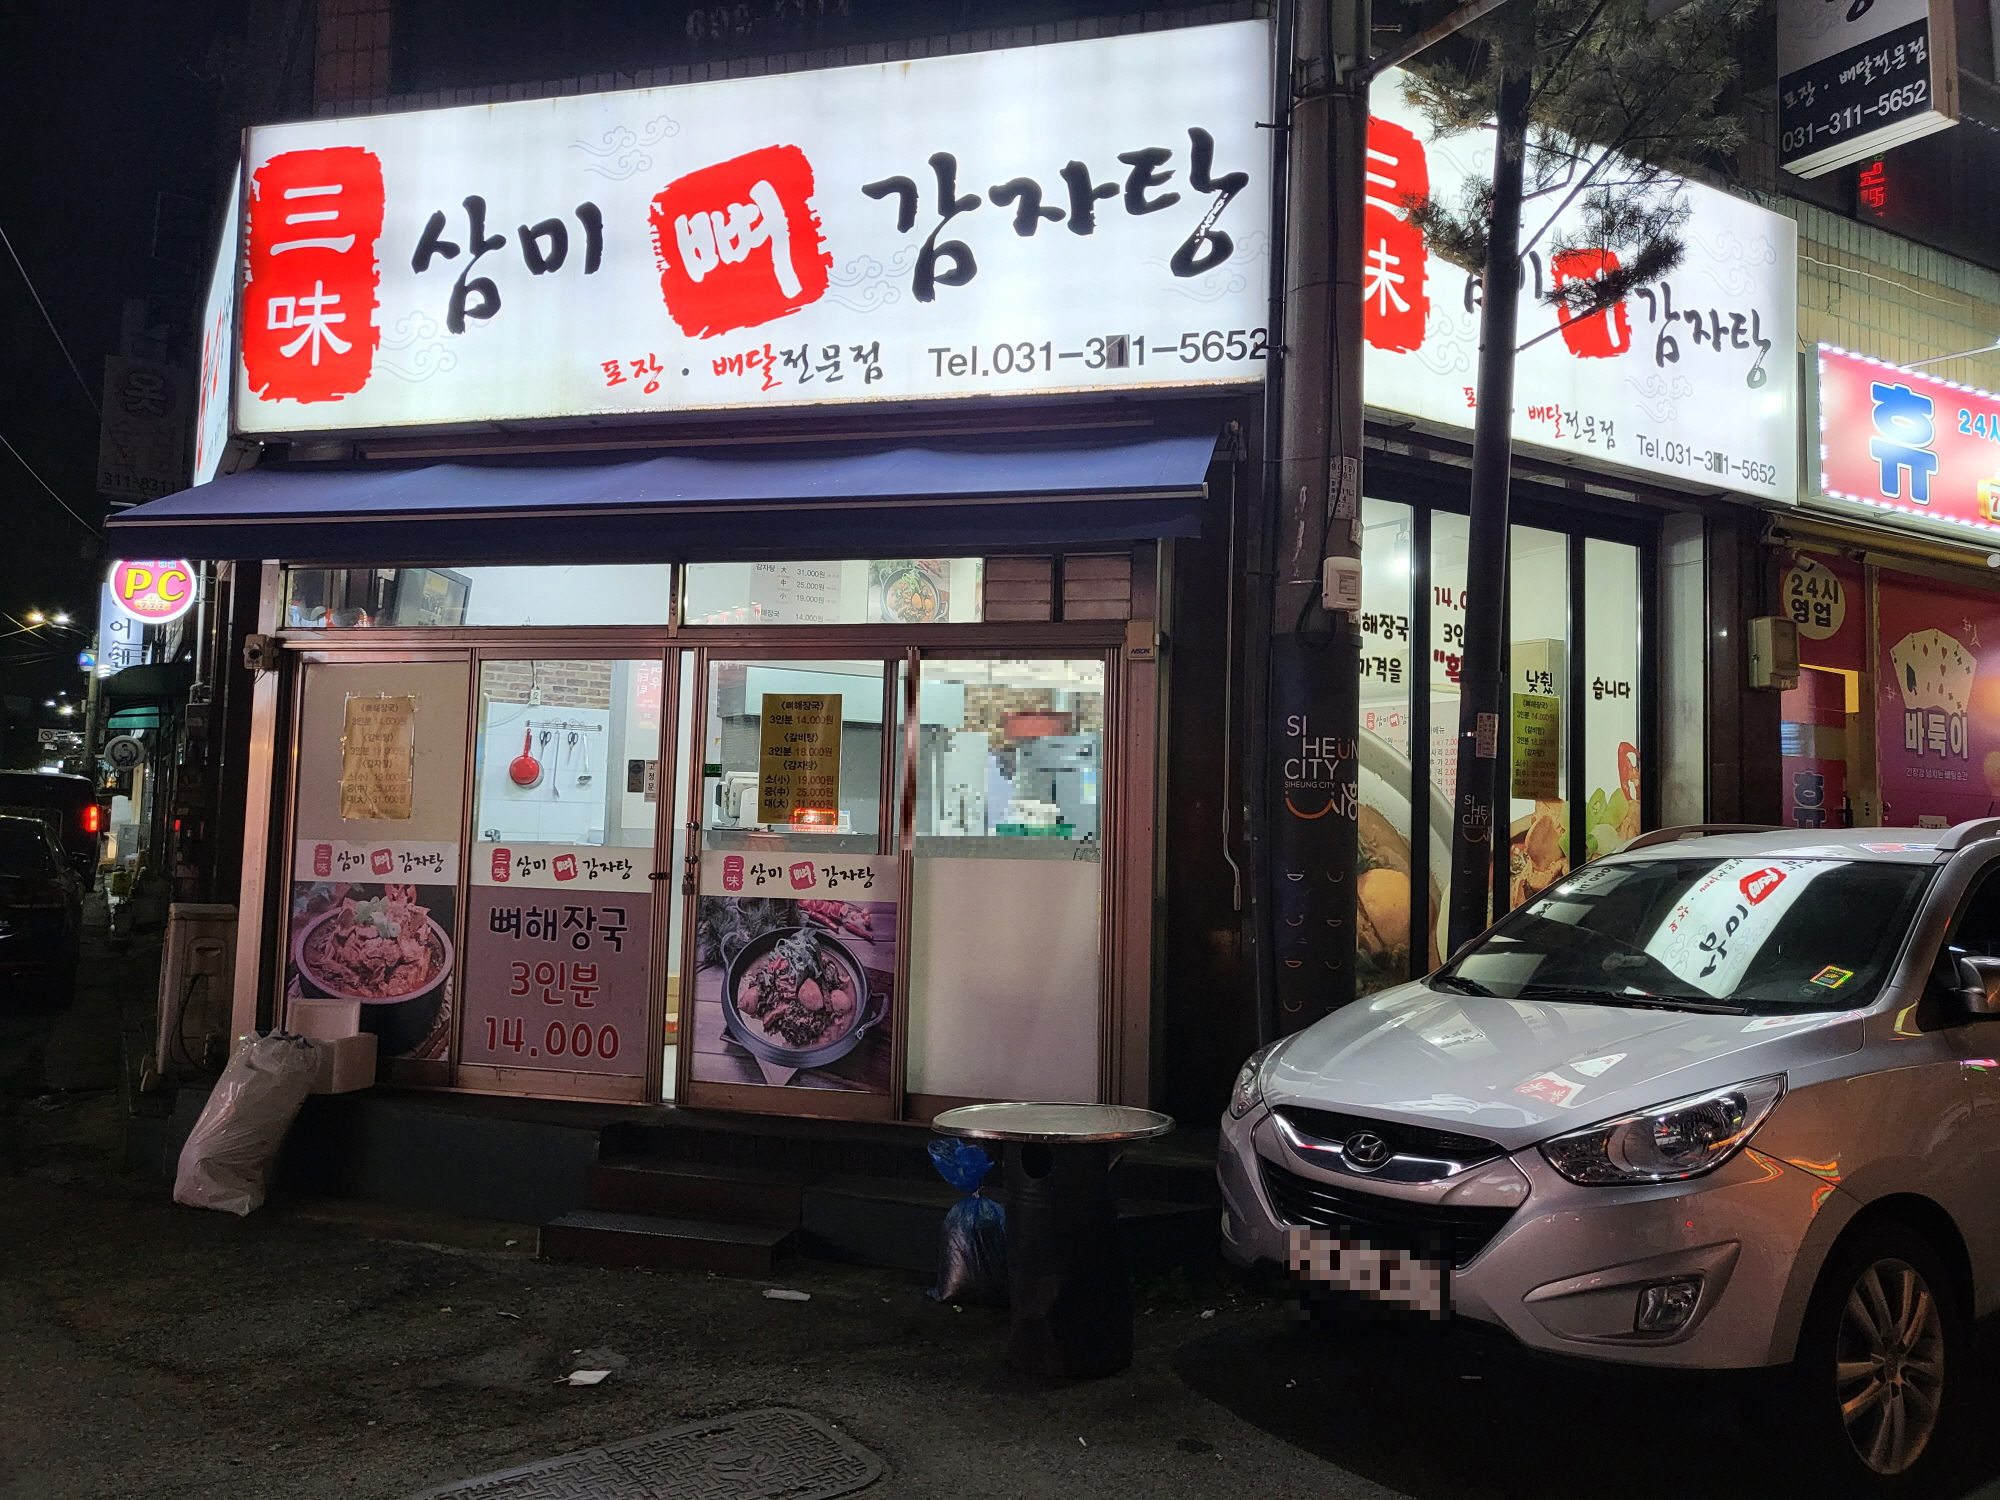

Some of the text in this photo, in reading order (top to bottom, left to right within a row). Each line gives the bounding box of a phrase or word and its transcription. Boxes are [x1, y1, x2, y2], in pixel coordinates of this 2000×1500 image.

[1783, 35, 1926, 110] 포장 배달전문점
[1783, 79, 1927, 152] 031-311-5652
[411, 195, 603, 335] 삼미
[861, 127, 1249, 304] 감자탕
[266, 184, 357, 367] 三味
[1634, 282, 1772, 389] 감자탕
[600, 340, 884, 394] 포장 배달전문점
[1527, 403, 1617, 450] 배달전문점
[1870, 381, 1939, 506] 휴
[1790, 573, 1839, 605] 24시
[1790, 600, 1832, 628] 영업
[1592, 676, 1631, 700] 습니다
[769, 715, 793, 725] 3인분
[1905, 708, 1969, 761] 바둑이
[768, 747, 792, 757] 3인분
[1284, 758, 1339, 780] CITY
[1462, 814, 1488, 825] CITY
[337, 851, 366, 871] 삼미
[398, 853, 444, 873] 감자탕
[516, 855, 547, 878] 삼미
[583, 857, 633, 880] 감자탕
[750, 863, 782, 885] 삼미
[821, 865, 875, 888] 감자탕
[489, 905, 628, 953] 뼈해장국
[510, 960, 601, 1009] 3인분
[485, 1016, 620, 1060] 14.000
